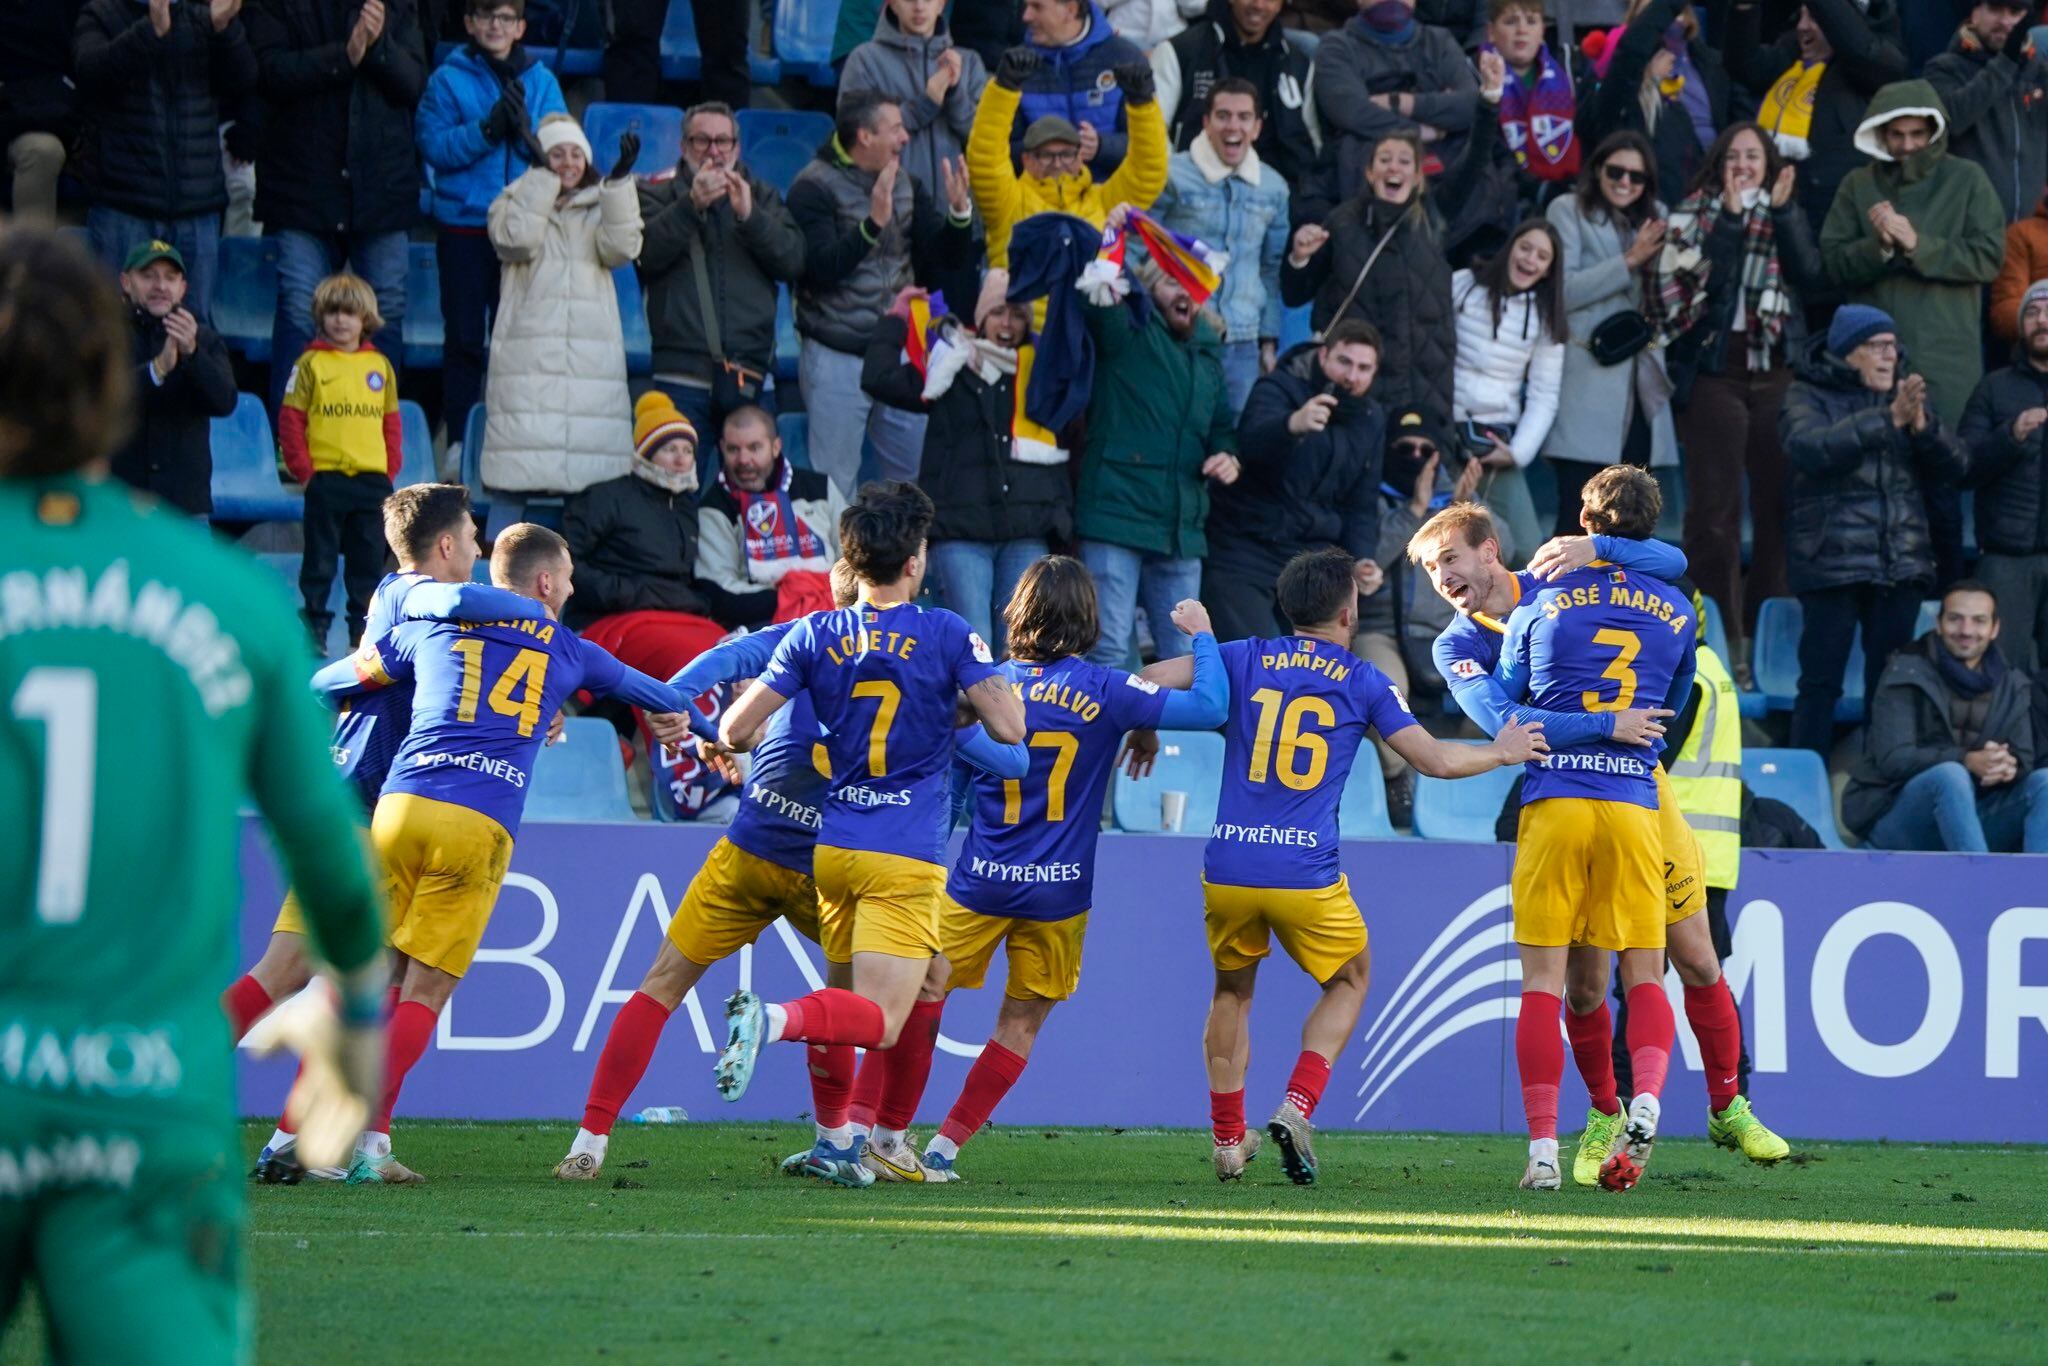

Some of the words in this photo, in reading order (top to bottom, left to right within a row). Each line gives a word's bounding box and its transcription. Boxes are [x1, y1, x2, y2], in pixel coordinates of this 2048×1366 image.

[1541, 583, 1601, 620] JOSÉ
[450, 638, 550, 738] 14
[1029, 682, 1101, 722] CALVO
[1261, 651, 1351, 682] PAMPÍN
[1582, 627, 1642, 713] 3
[851, 680, 902, 778] 7
[1248, 687, 1336, 791] 16
[10, 664, 99, 926] 1
